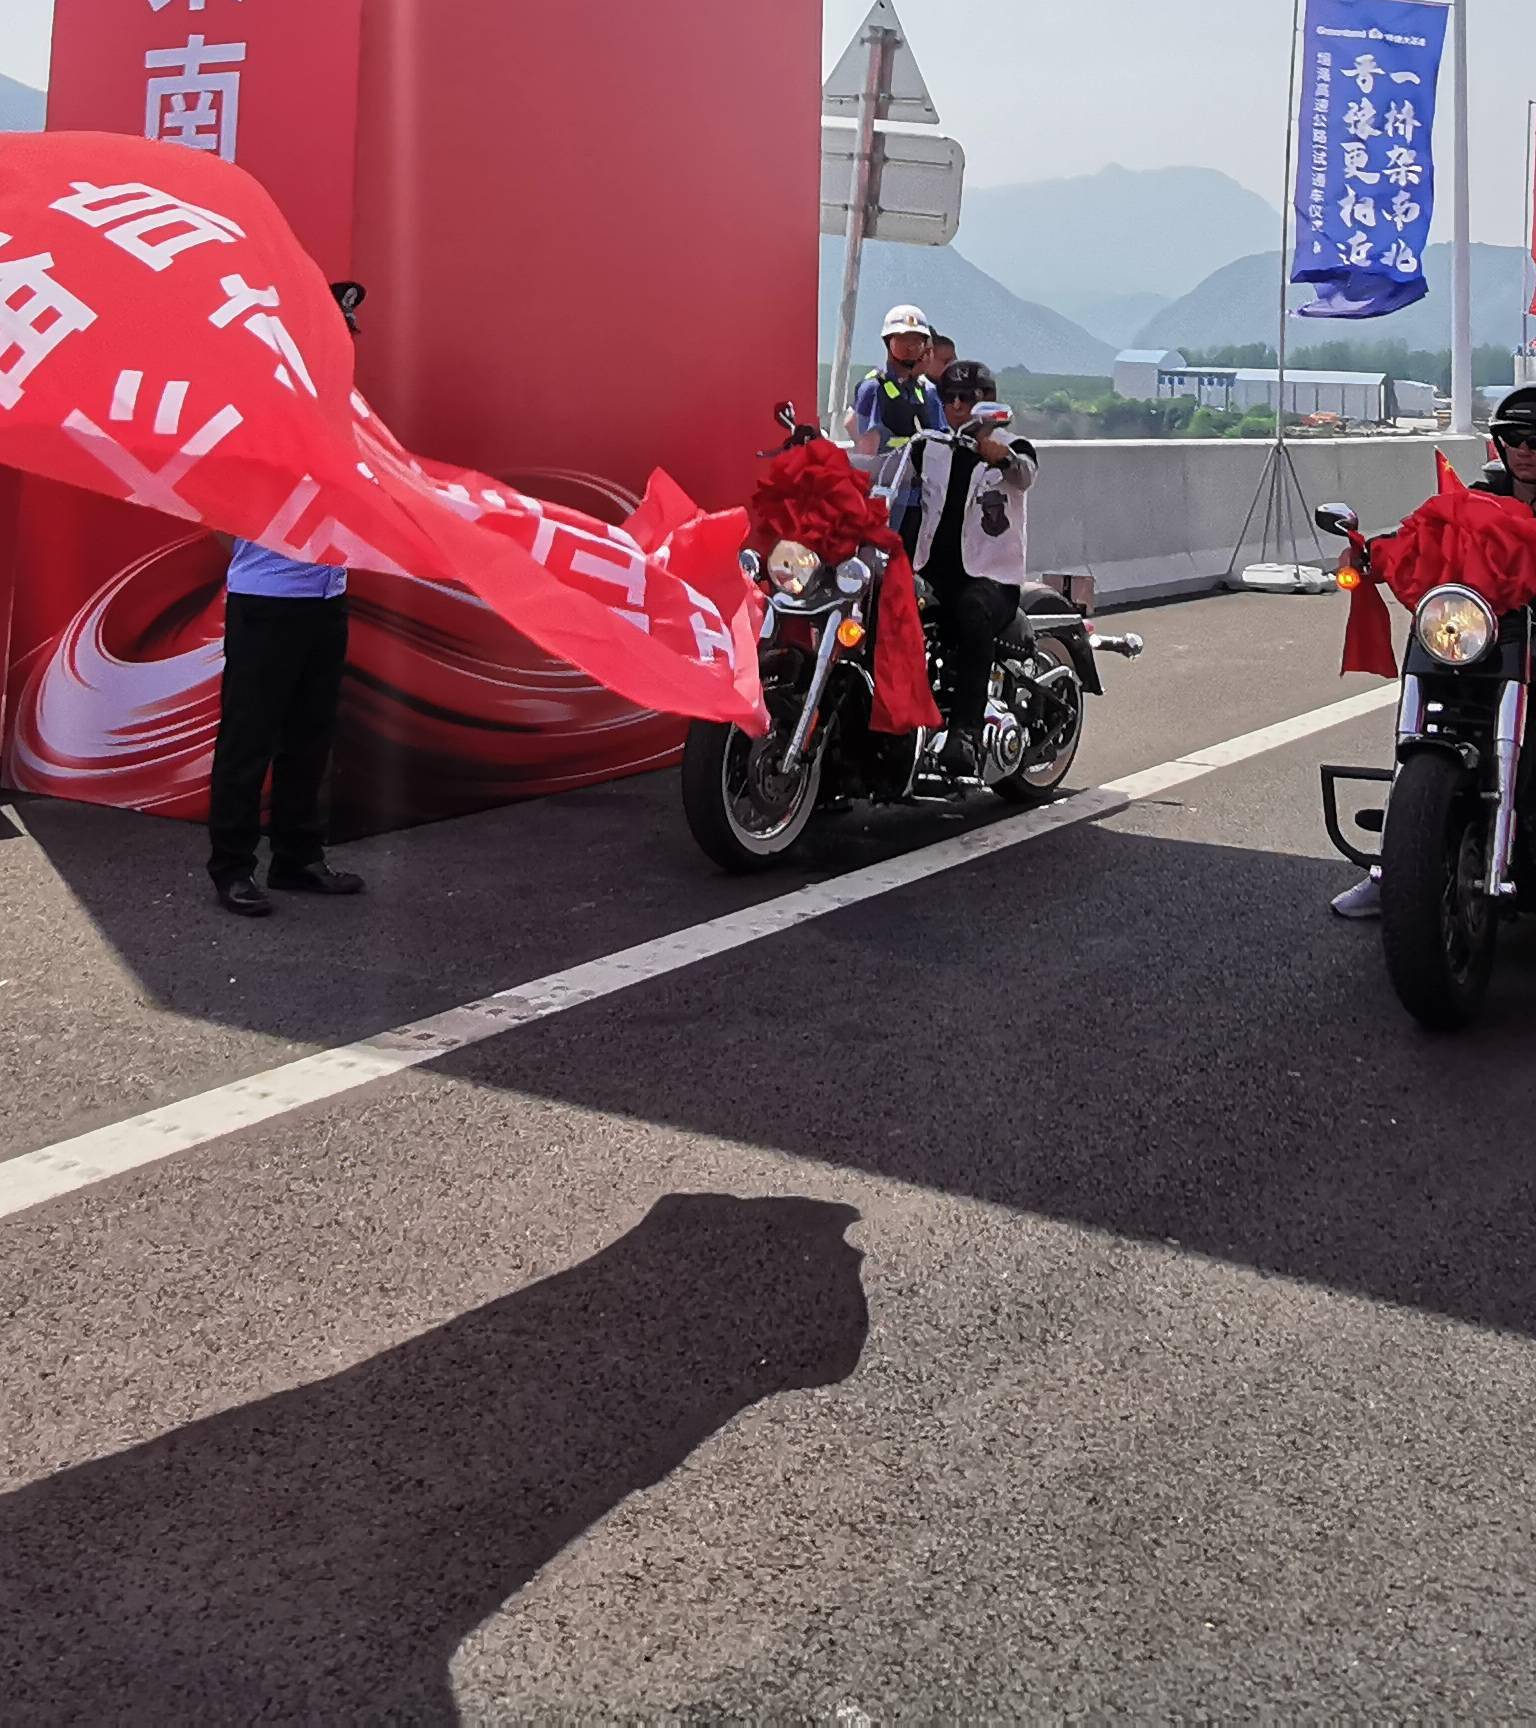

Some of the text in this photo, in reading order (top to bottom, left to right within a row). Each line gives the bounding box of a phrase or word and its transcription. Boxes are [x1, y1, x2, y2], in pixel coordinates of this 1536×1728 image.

[1337, 54, 1386, 269] 晋豫更相近
[1380, 70, 1424, 273] 一桥架南北
